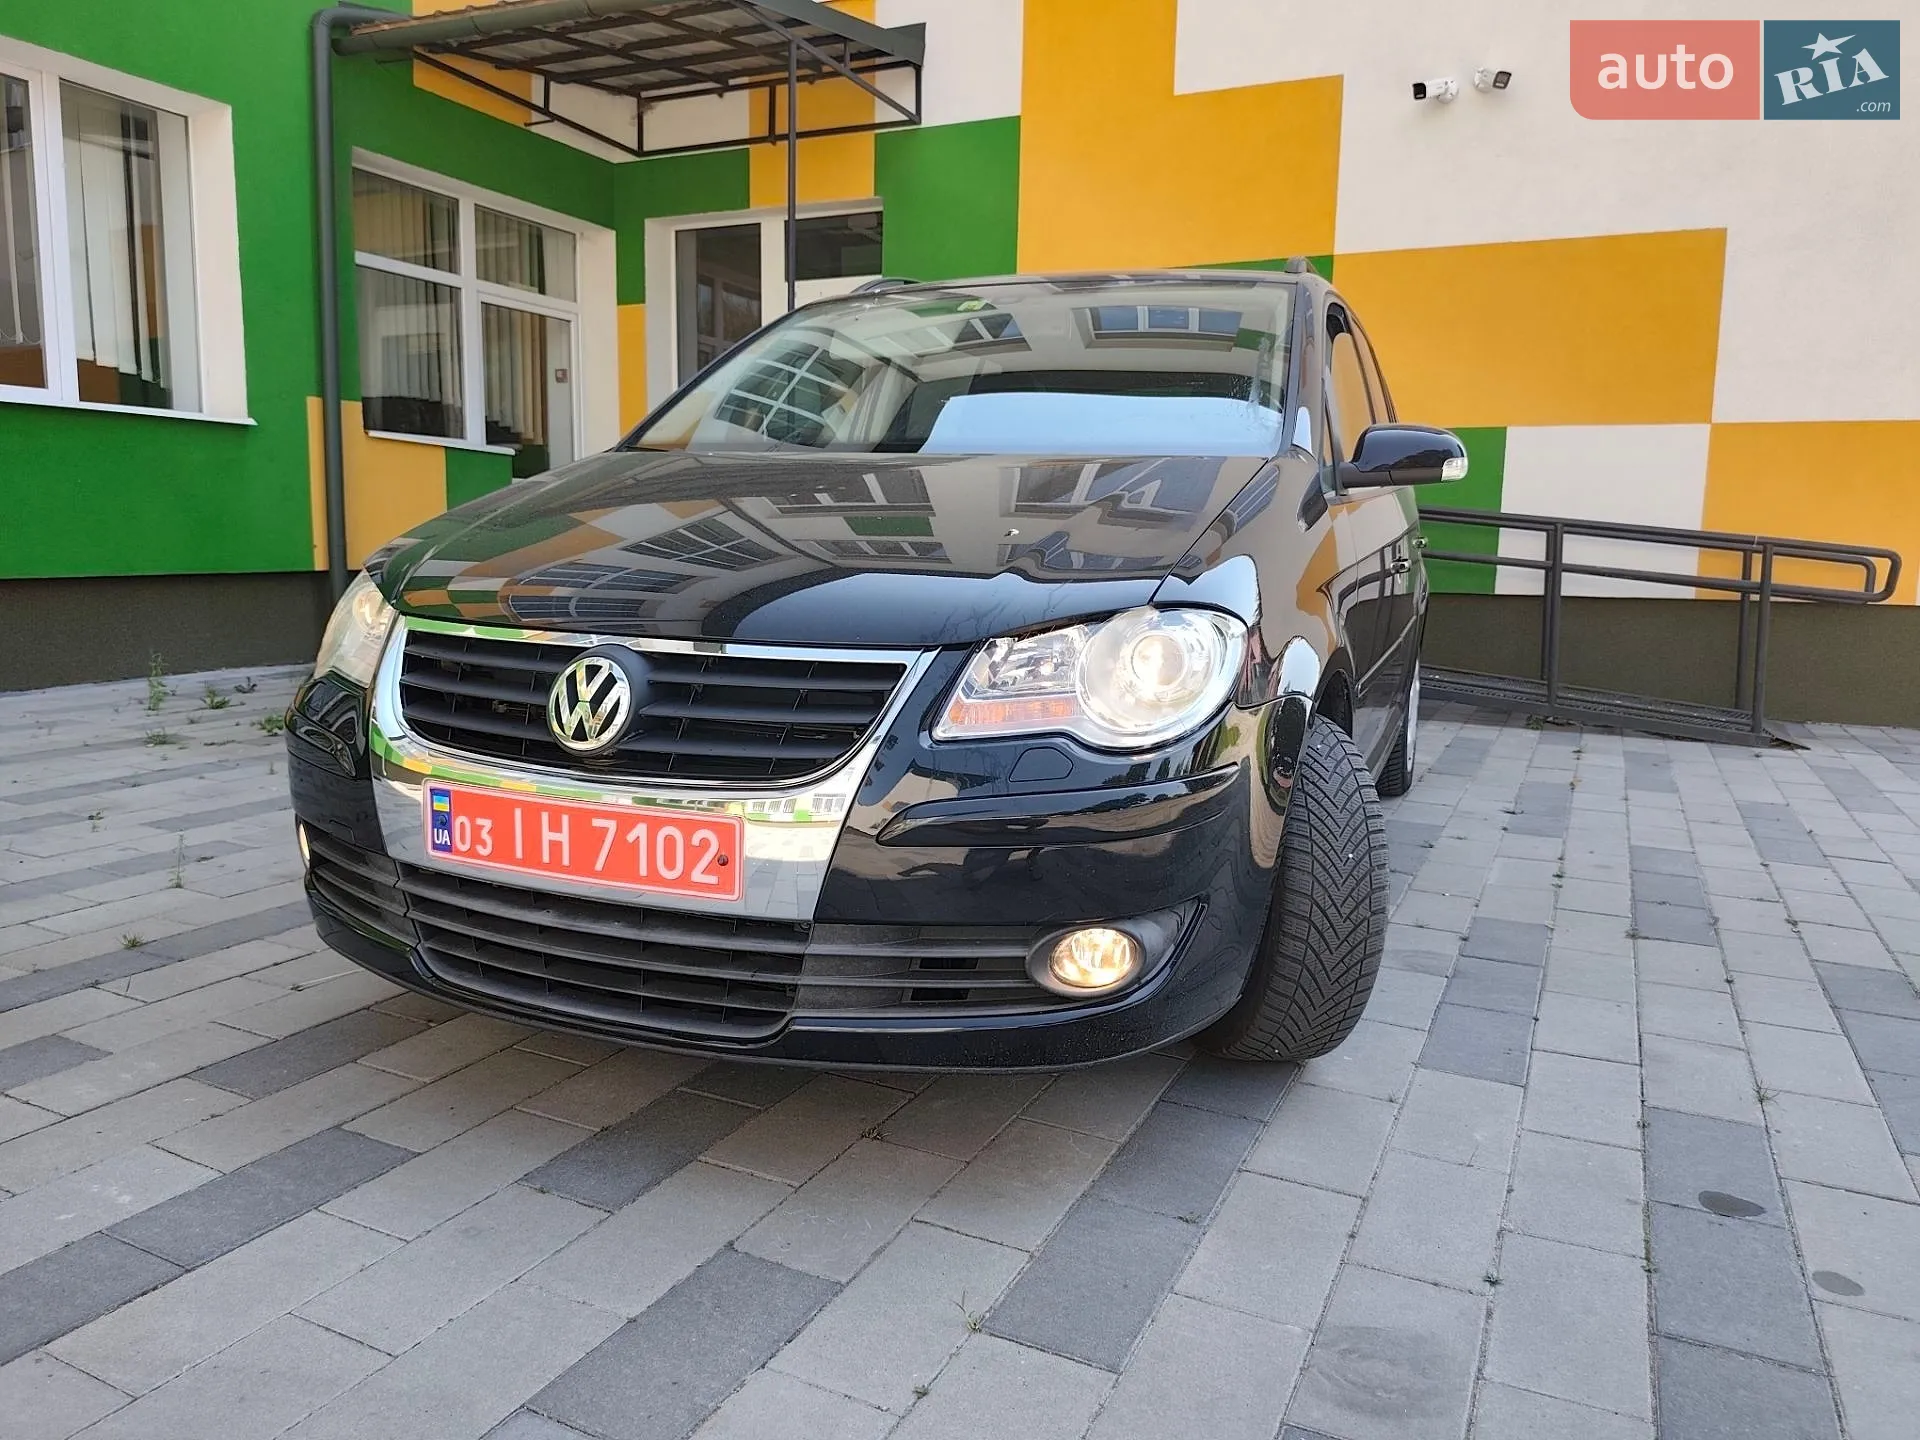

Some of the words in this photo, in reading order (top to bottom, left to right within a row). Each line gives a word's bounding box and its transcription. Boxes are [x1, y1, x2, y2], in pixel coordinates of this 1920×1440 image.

[434, 828, 450, 846] UA
[455, 816, 493, 857] 03
[514, 807, 571, 867] IH
[591, 818, 721, 885] 7102
